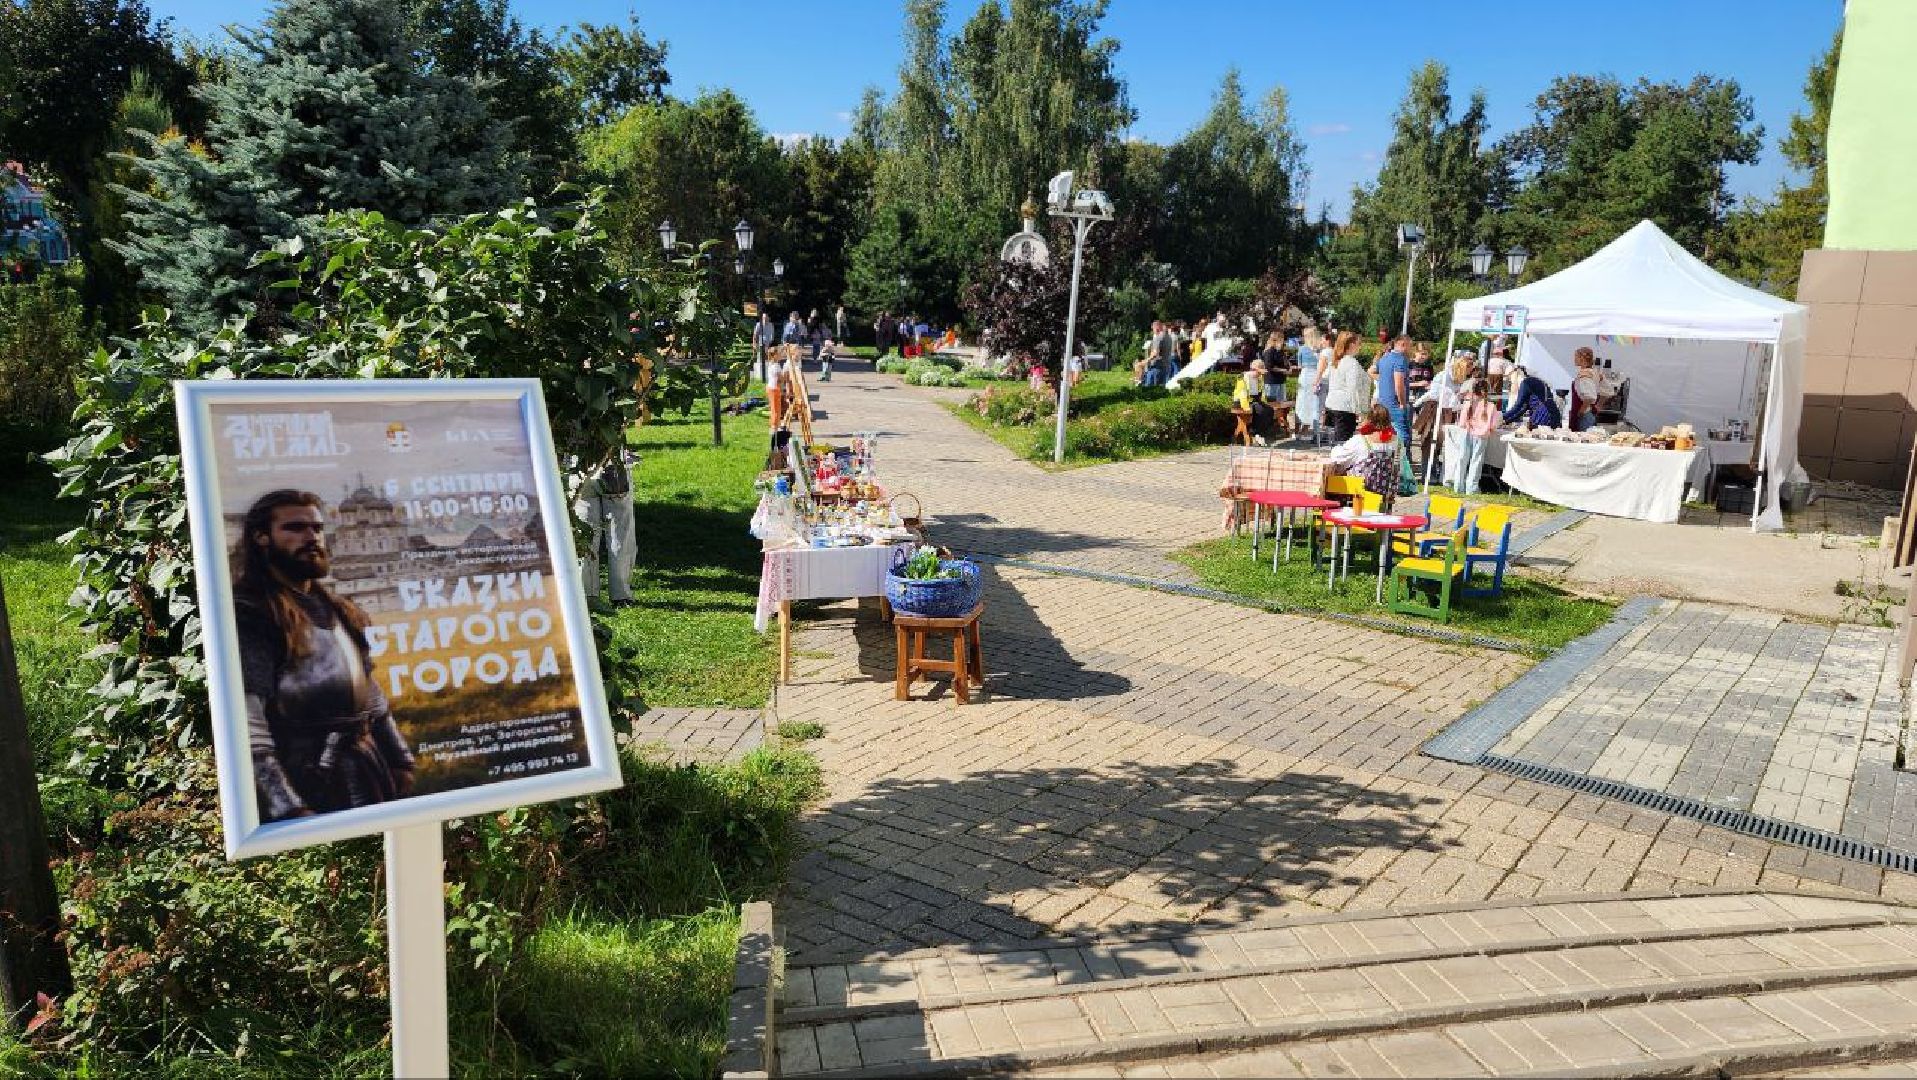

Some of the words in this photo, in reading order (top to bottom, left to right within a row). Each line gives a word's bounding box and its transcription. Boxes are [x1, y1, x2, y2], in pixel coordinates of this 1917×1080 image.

[386, 479, 398, 496] 6
[406, 494, 529, 519] 11:00-16:00
[400, 569, 545, 612] СКАЗКИ
[365, 608, 552, 657] СТАРОГО
[388, 647, 561, 697] ГОРОДА
[460, 722, 497, 734] Адрес
